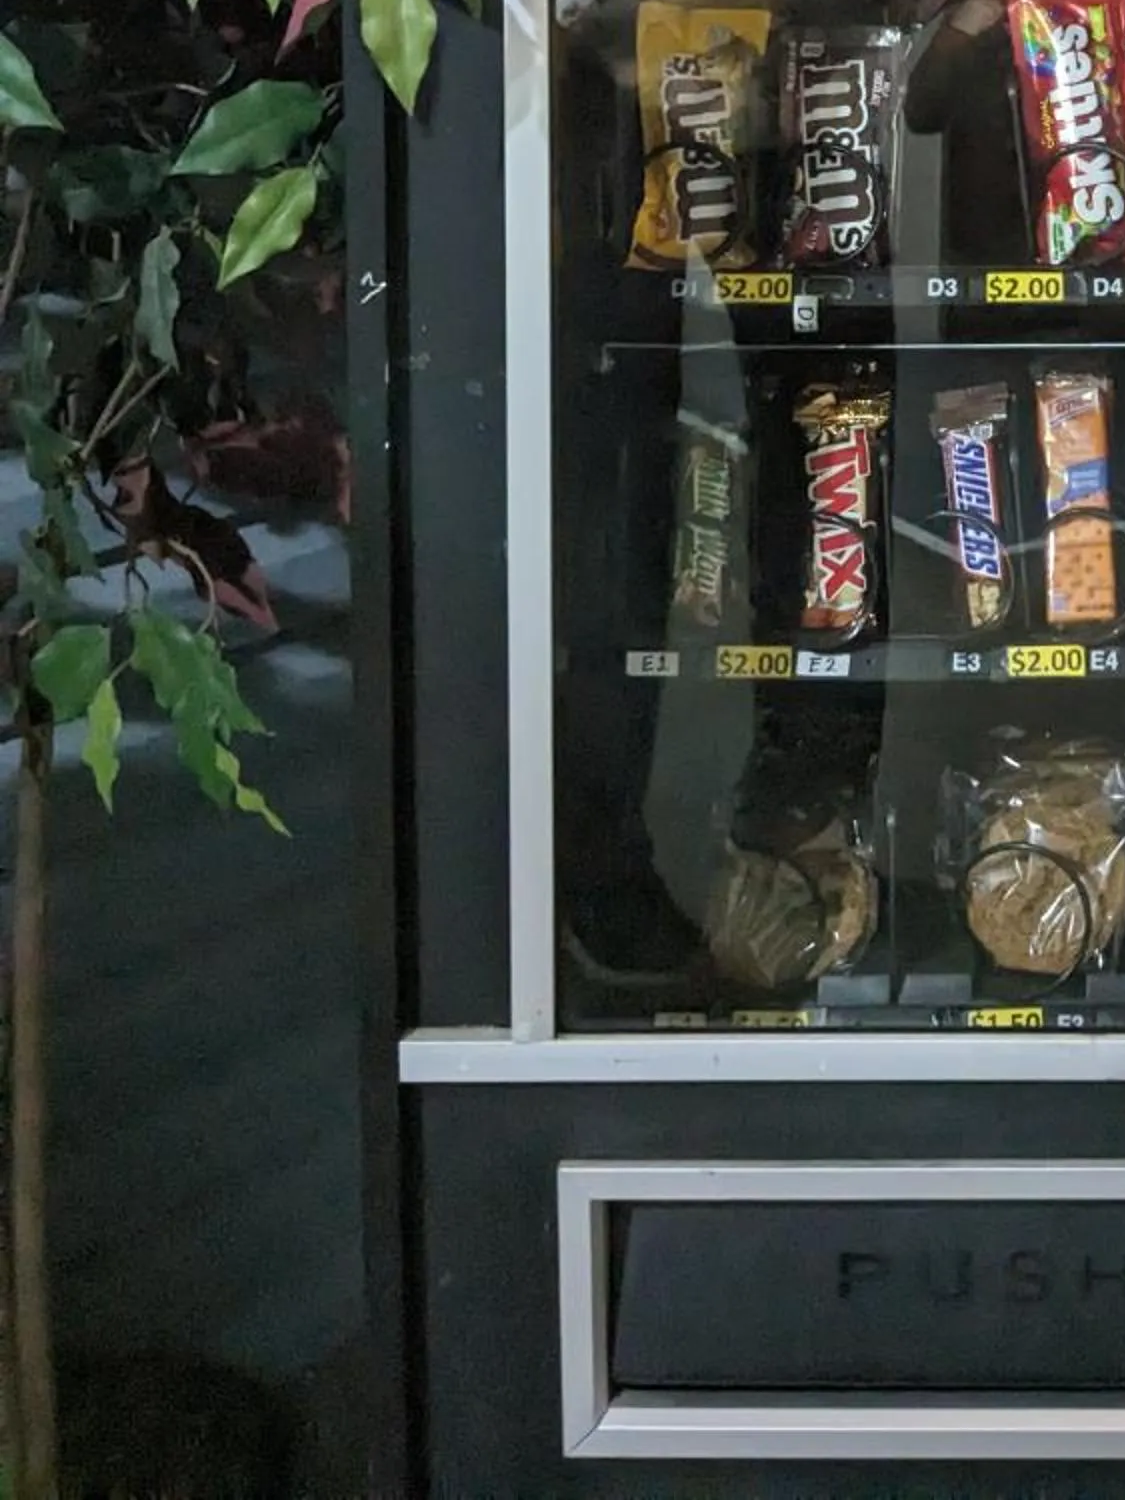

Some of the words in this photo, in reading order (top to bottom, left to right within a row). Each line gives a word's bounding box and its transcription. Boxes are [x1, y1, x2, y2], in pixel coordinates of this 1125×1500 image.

[1050, 24, 1125, 224] Skttles
[671, 279, 698, 297] D1
[718, 276, 790, 300] $2.00
[926, 277, 959, 296] D3
[988, 277, 1061, 300] $2.00
[1092, 277, 1123, 296] D4
[804, 423, 871, 604] TWIX
[641, 654, 669, 672] E1
[718, 651, 790, 676] $2.00
[808, 656, 838, 673] E2
[952, 652, 981, 672] E3
[1011, 648, 1083, 674] $2.00
[1090, 651, 1119, 671] E4
